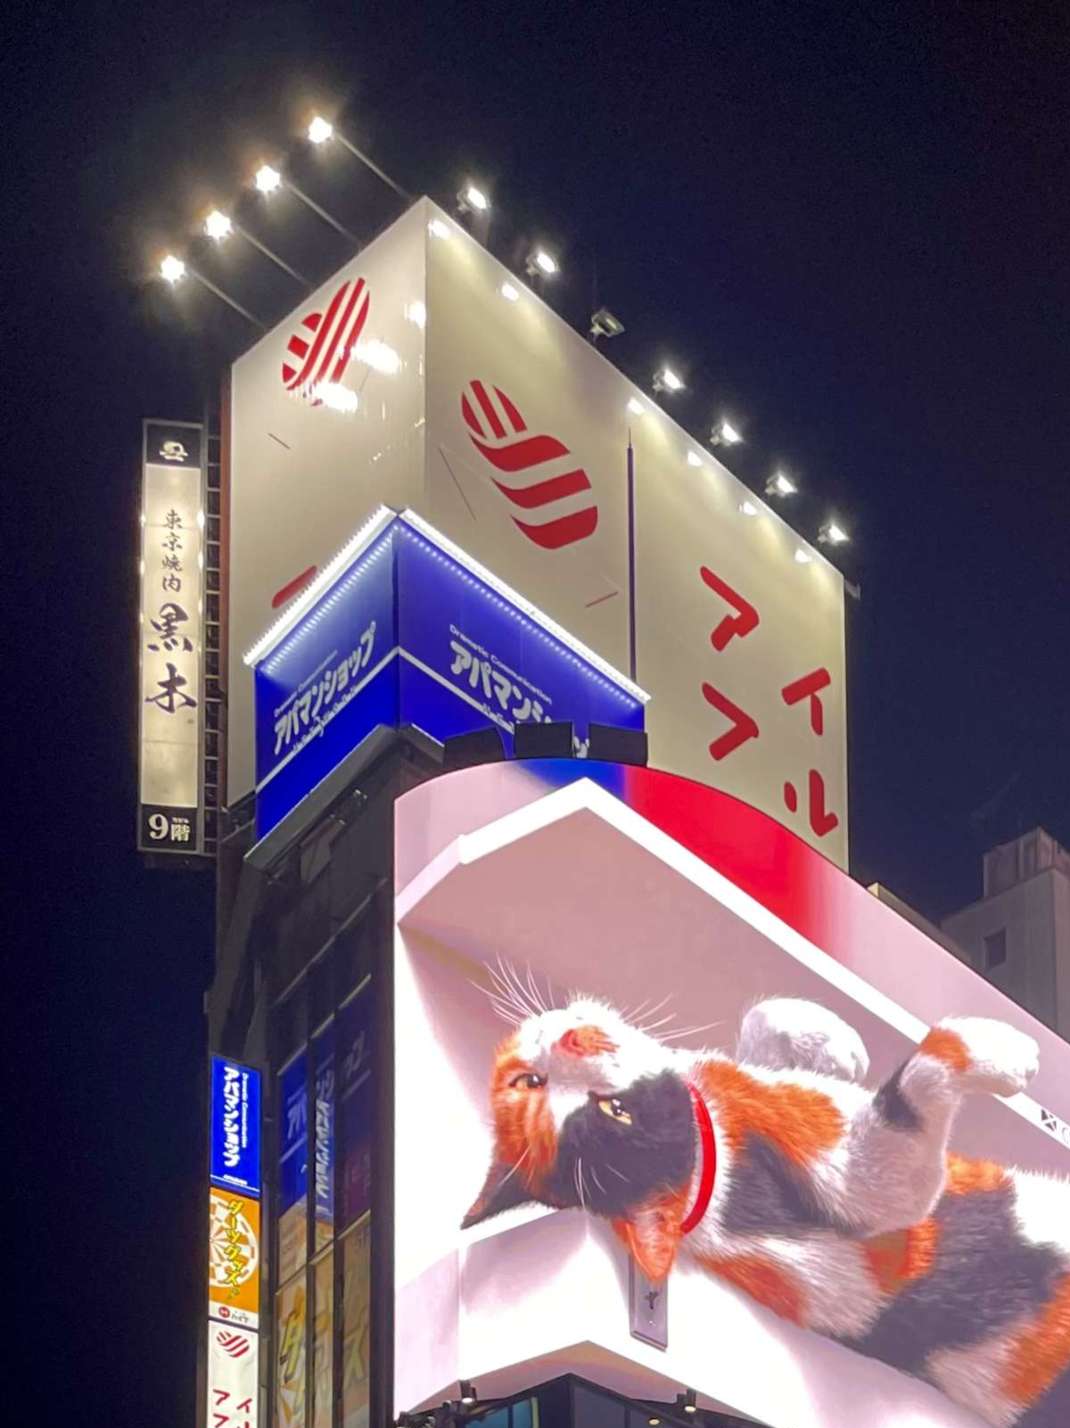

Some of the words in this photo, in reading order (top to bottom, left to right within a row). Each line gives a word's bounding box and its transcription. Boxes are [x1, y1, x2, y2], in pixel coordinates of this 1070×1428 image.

[160, 508, 184, 593] 東京焼肉
[146, 602, 198, 713] 黒木
[274, 620, 377, 755] アパマンショップ
[147, 813, 190, 842] 9階
